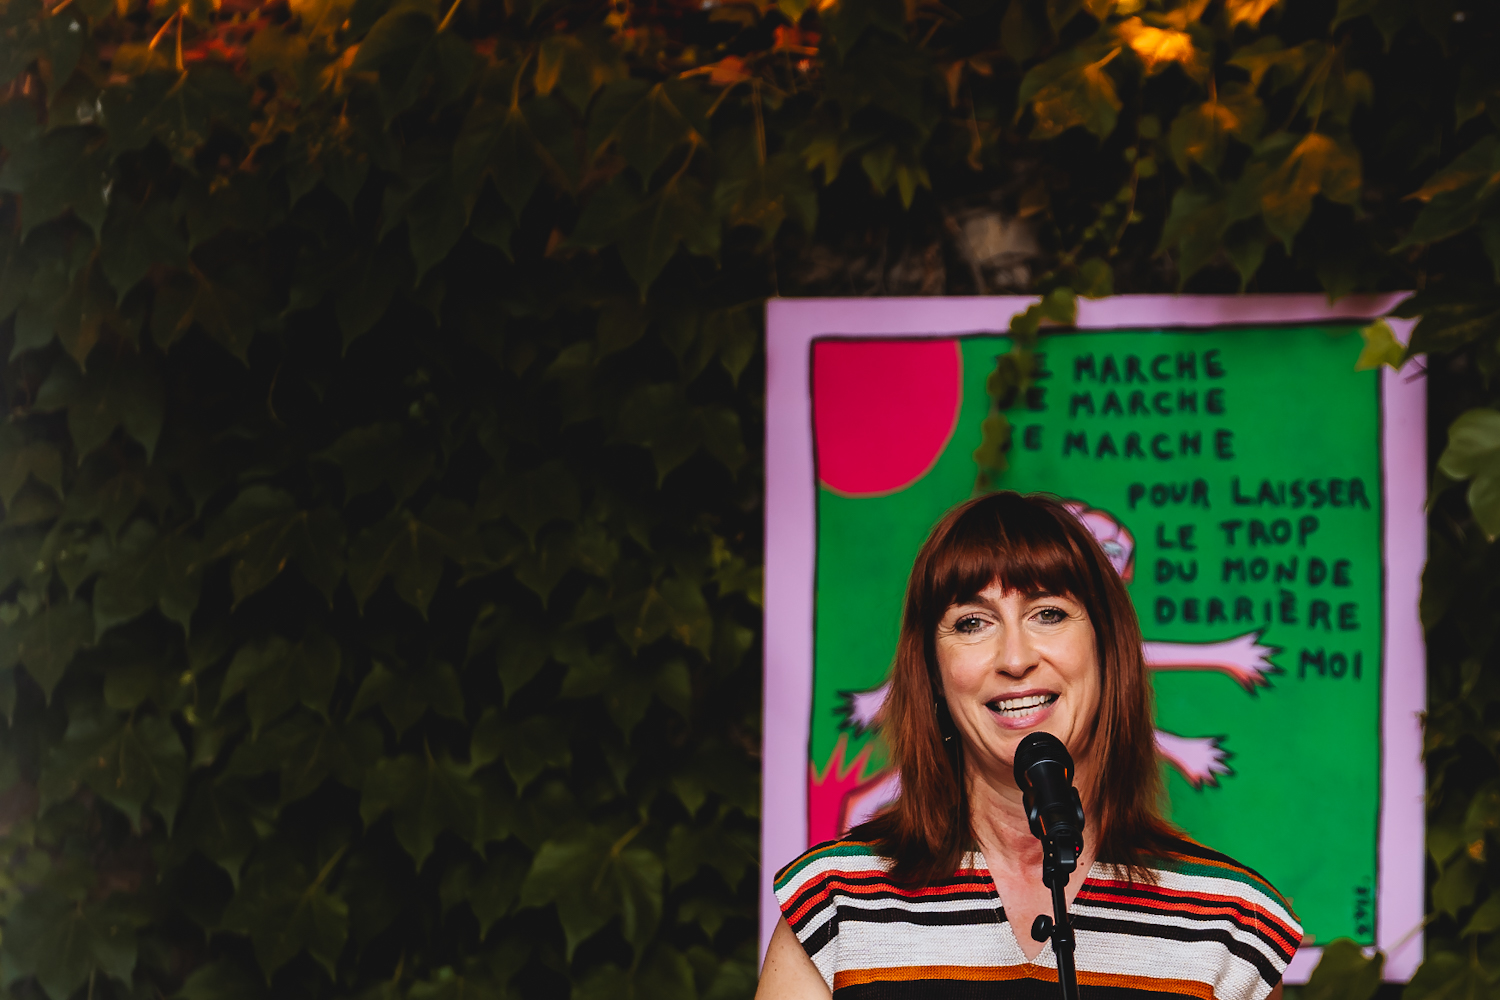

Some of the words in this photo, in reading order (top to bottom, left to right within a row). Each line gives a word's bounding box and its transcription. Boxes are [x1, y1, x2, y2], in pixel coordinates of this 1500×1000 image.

[1073, 350, 1227, 383] MARCHE
[1069, 387, 1226, 418] MARCHE
[1062, 428, 1236, 461] MARCHE
[1128, 478, 1211, 512] POUR
[1231, 476, 1371, 511] LAISSER
[1156, 522, 1197, 550] LE
[1219, 515, 1319, 548] TROP
[1155, 558, 1198, 584] DU
[1222, 555, 1352, 588] MONDE
[1155, 589, 1360, 631] DERRIÈRE
[1298, 647, 1363, 681] MOI
